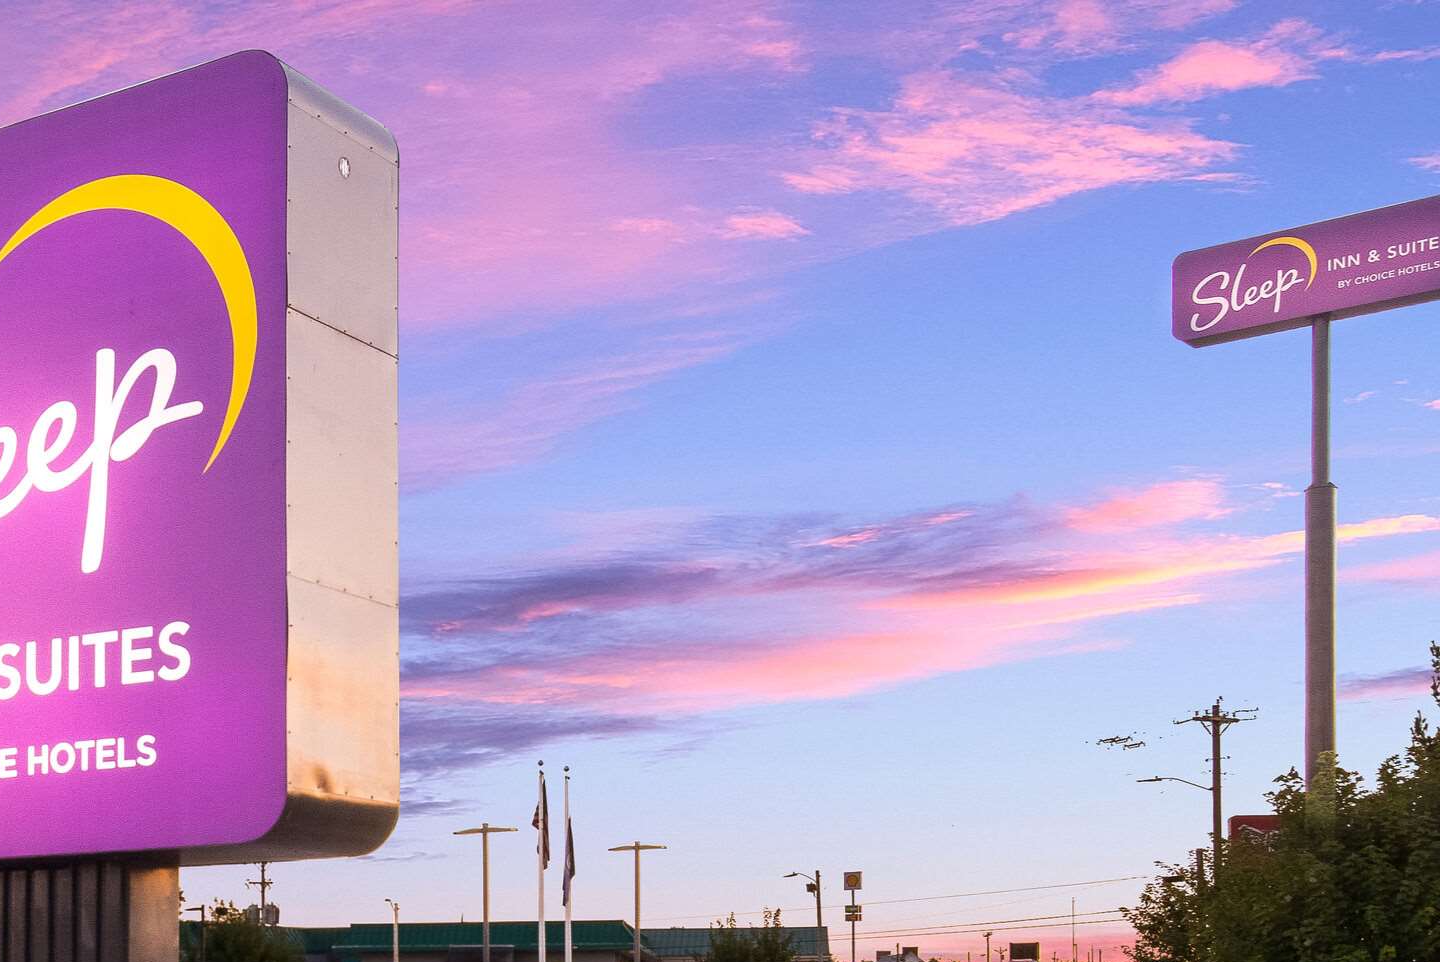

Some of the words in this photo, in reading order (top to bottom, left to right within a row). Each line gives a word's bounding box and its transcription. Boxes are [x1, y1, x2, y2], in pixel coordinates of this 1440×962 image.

[1327, 253, 1361, 271] INN
[1367, 249, 1381, 263] &
[1387, 236, 1440, 259] SUITE
[1337, 278, 1353, 289] BY
[1354, 269, 1396, 285] CHOICE
[1397, 260, 1440, 276] HOTELS
[1190, 263, 1305, 332] Sleep
[27, 735, 157, 776] HOTELS
